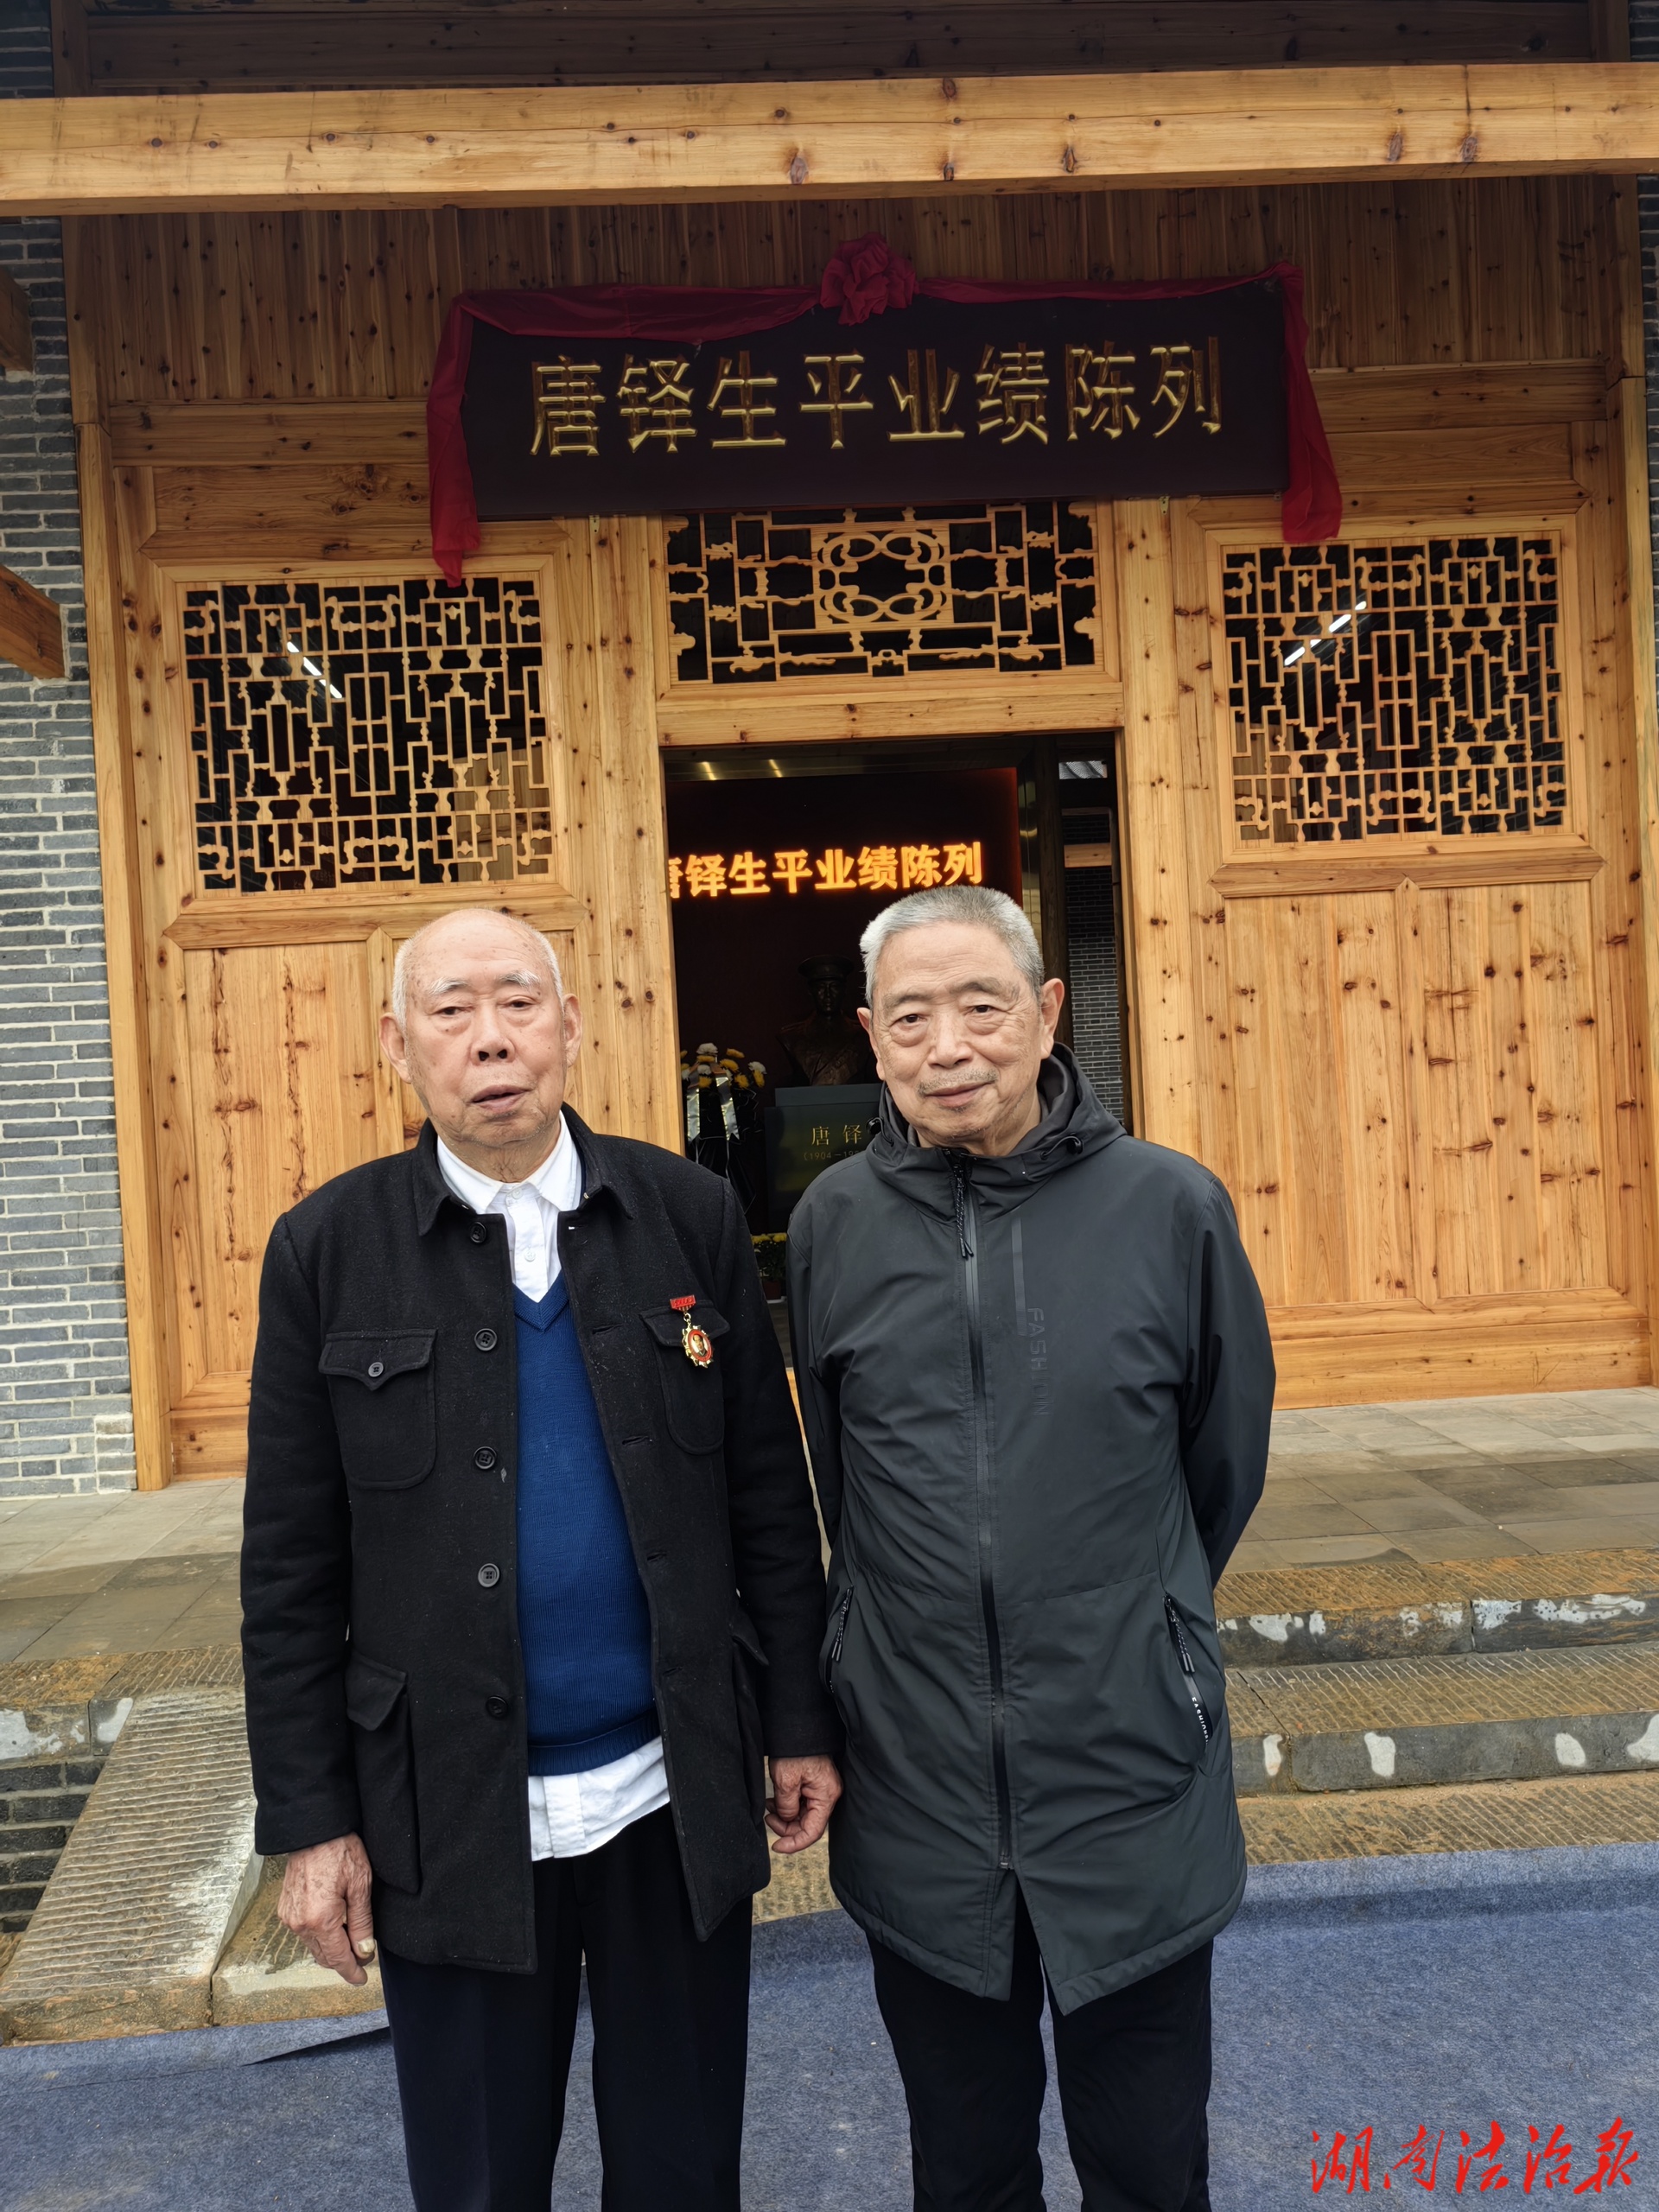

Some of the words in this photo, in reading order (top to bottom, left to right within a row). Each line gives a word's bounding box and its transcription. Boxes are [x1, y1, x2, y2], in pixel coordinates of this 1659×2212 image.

[529, 336, 1222, 456] 唐铎生平业绩陈列
[811, 1124, 862, 1146] 唐铎
